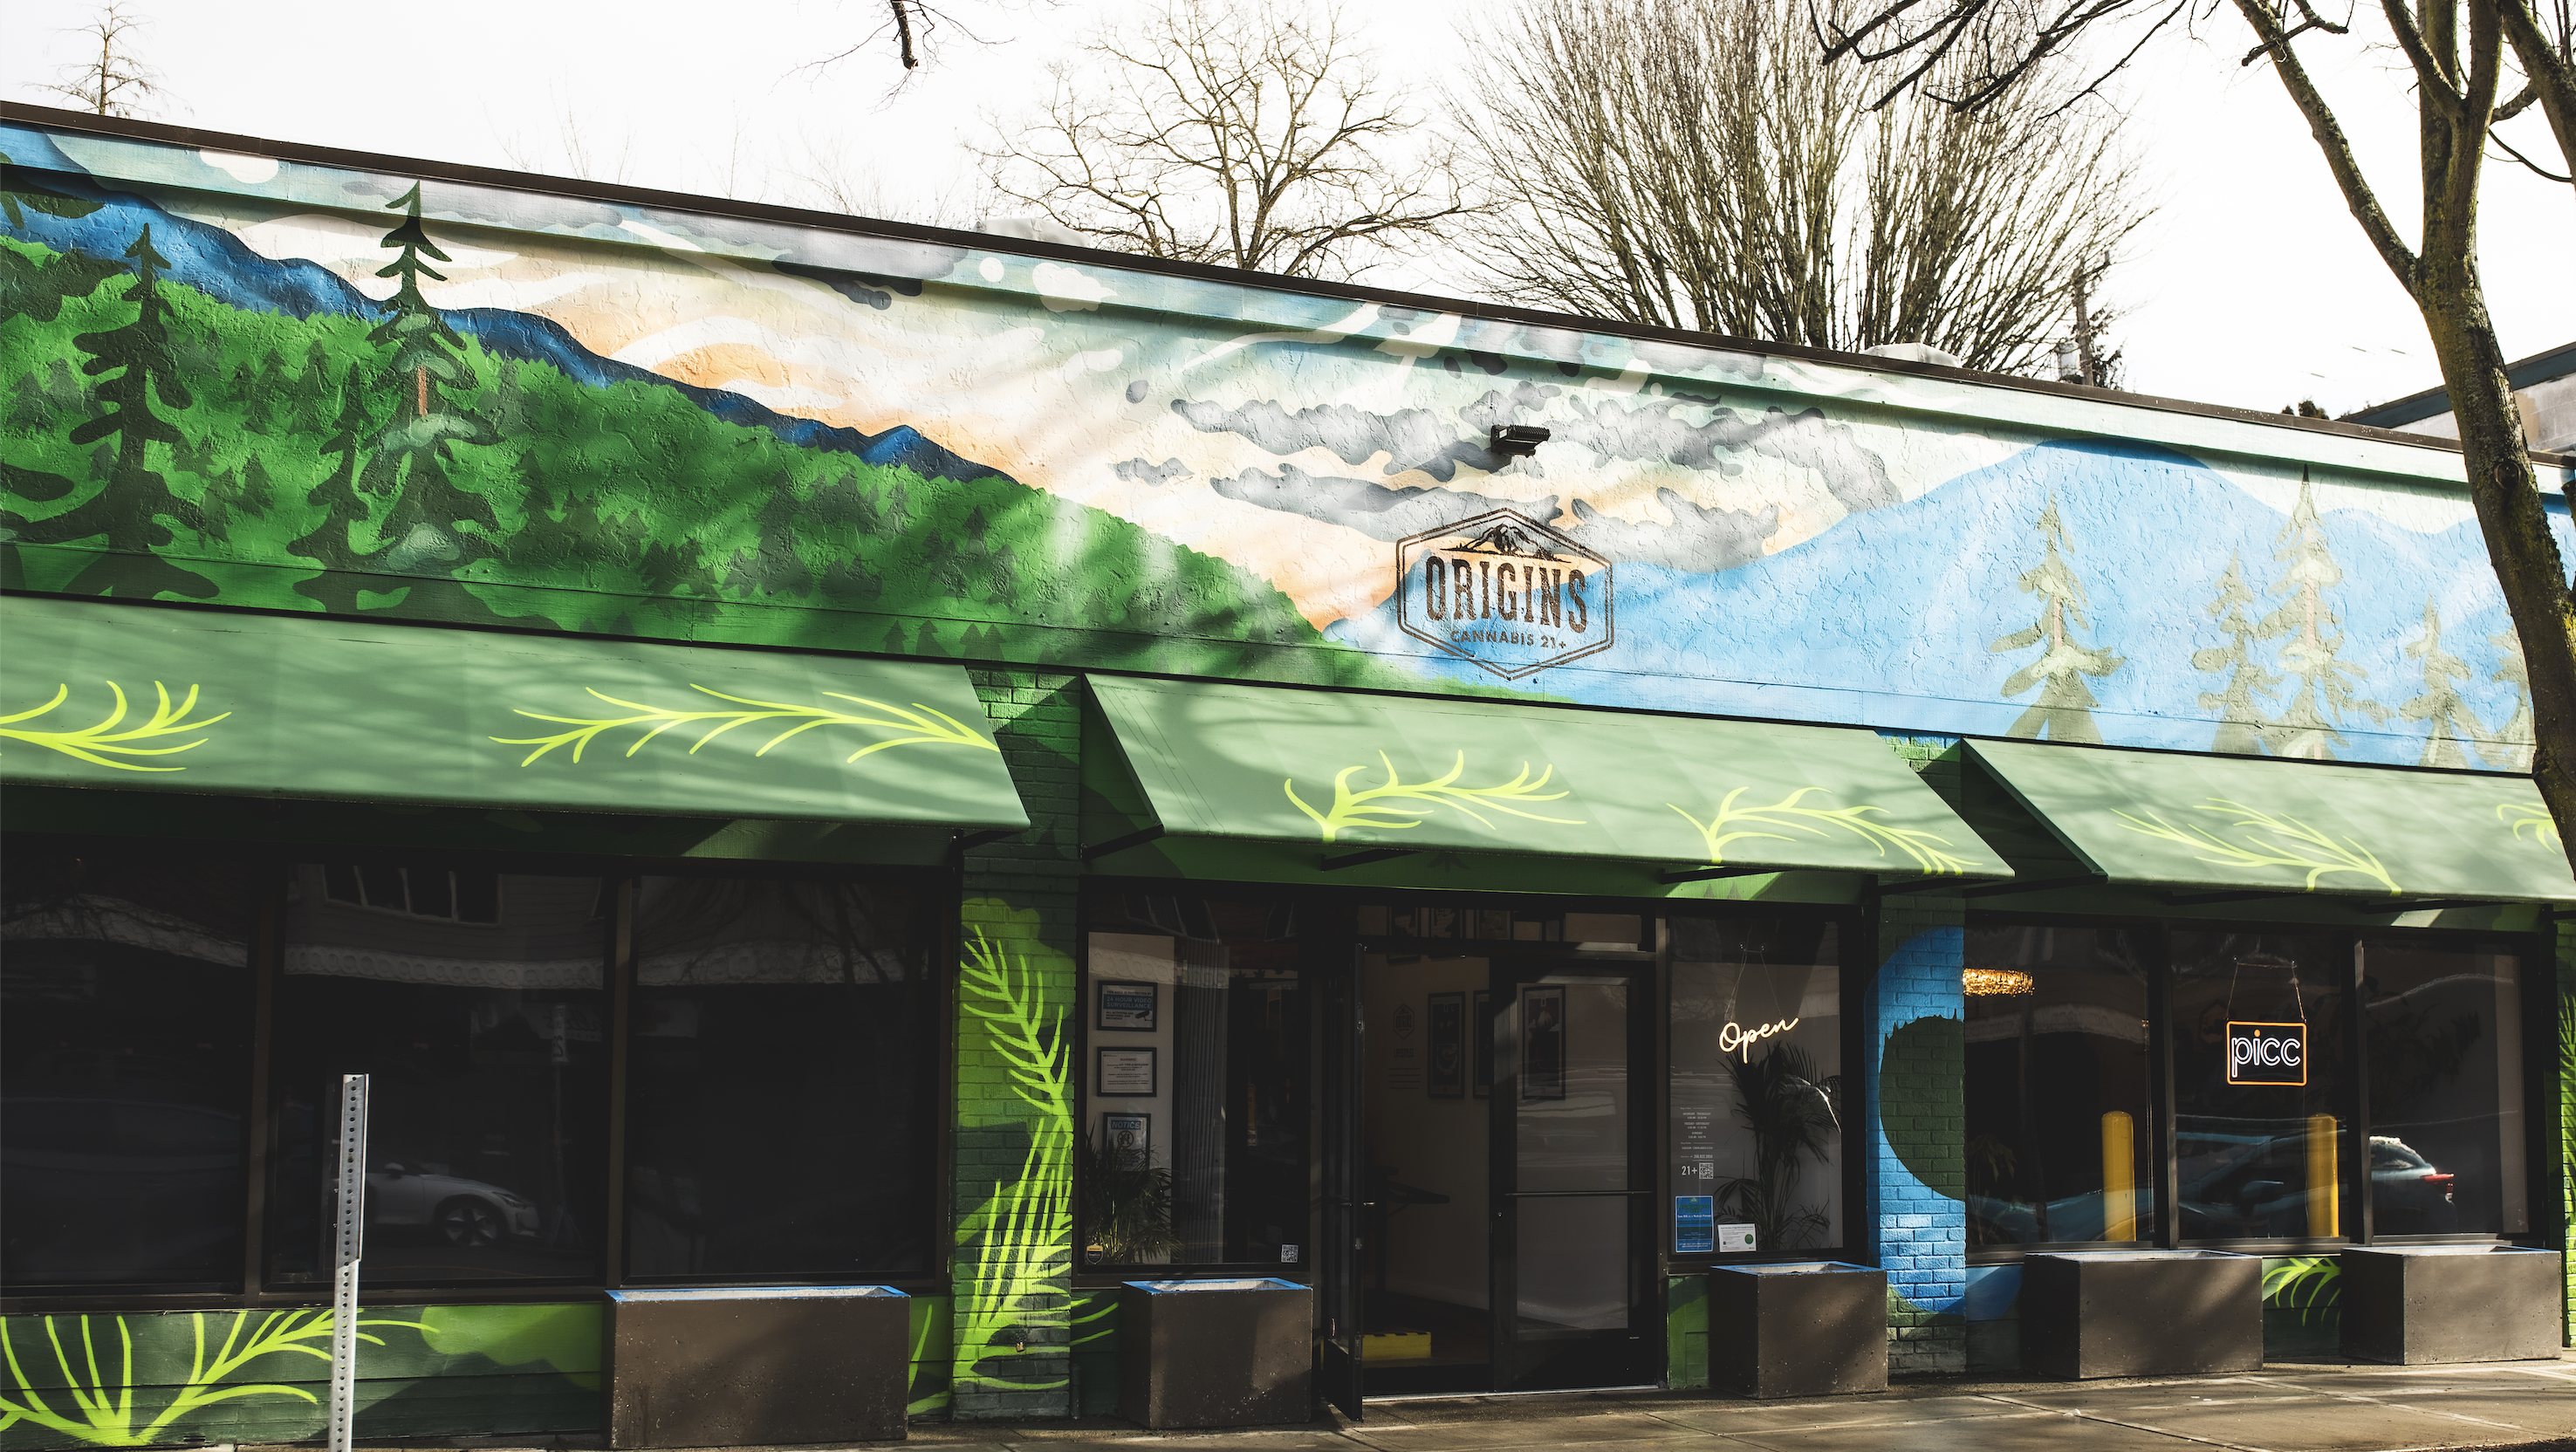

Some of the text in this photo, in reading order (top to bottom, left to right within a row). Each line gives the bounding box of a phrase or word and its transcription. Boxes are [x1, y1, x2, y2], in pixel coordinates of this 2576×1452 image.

[1425, 556, 1587, 634] ORIGINS
[1450, 630, 1567, 649] CANNABIS 21+
[1718, 1017, 1799, 1064] Open
[2231, 1029, 2301, 1078] picc
[1682, 1165, 1698, 1176] 21+
